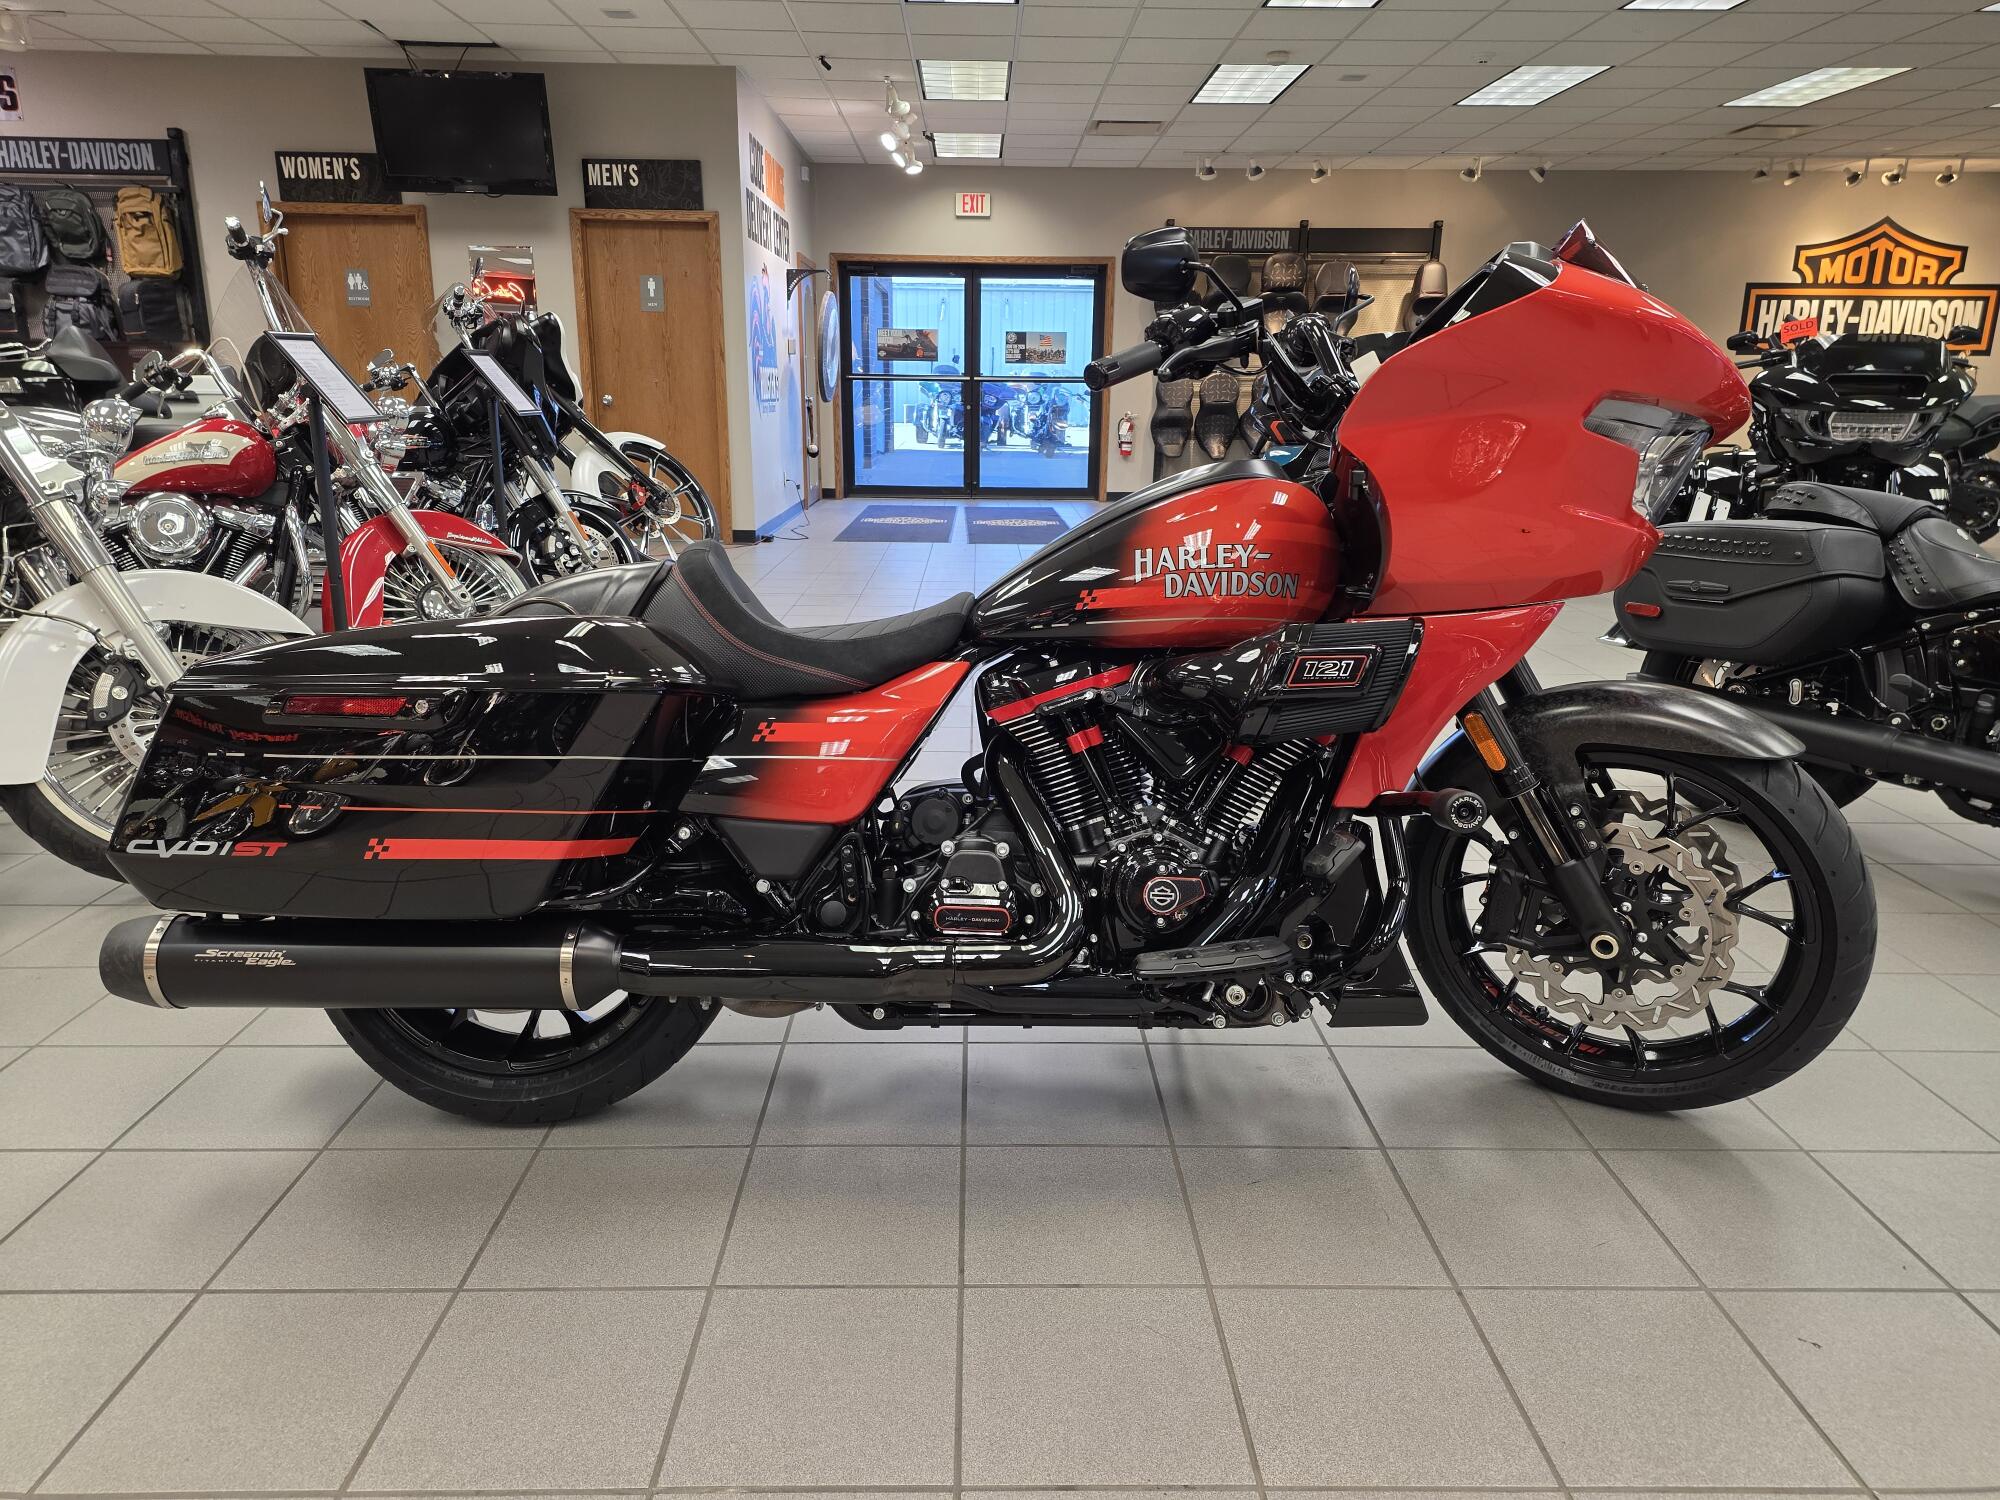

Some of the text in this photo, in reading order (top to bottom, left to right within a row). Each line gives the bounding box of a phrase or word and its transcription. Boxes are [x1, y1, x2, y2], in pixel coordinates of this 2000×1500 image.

[0, 139, 156, 171] HARLEY-DAVIDSON
[280, 156, 361, 180] WOMEN'S
[587, 163, 640, 187] MEN'S
[962, 193, 986, 213] EXIT
[1191, 229, 1290, 250] ARLEY-DAVIDSON
[1817, 237, 1940, 285] MOTOR
[1783, 320, 1814, 334] SOLD
[1134, 543, 1272, 584] HARLEY-
[1164, 570, 1300, 599] DAVIDSON
[1303, 660, 1354, 677] 121
[1452, 796, 1482, 808] HARLEY
[1450, 813, 1483, 829] DAVIDSON
[194, 948, 287, 958] Screamin'
[245, 957, 297, 968] Eagle
